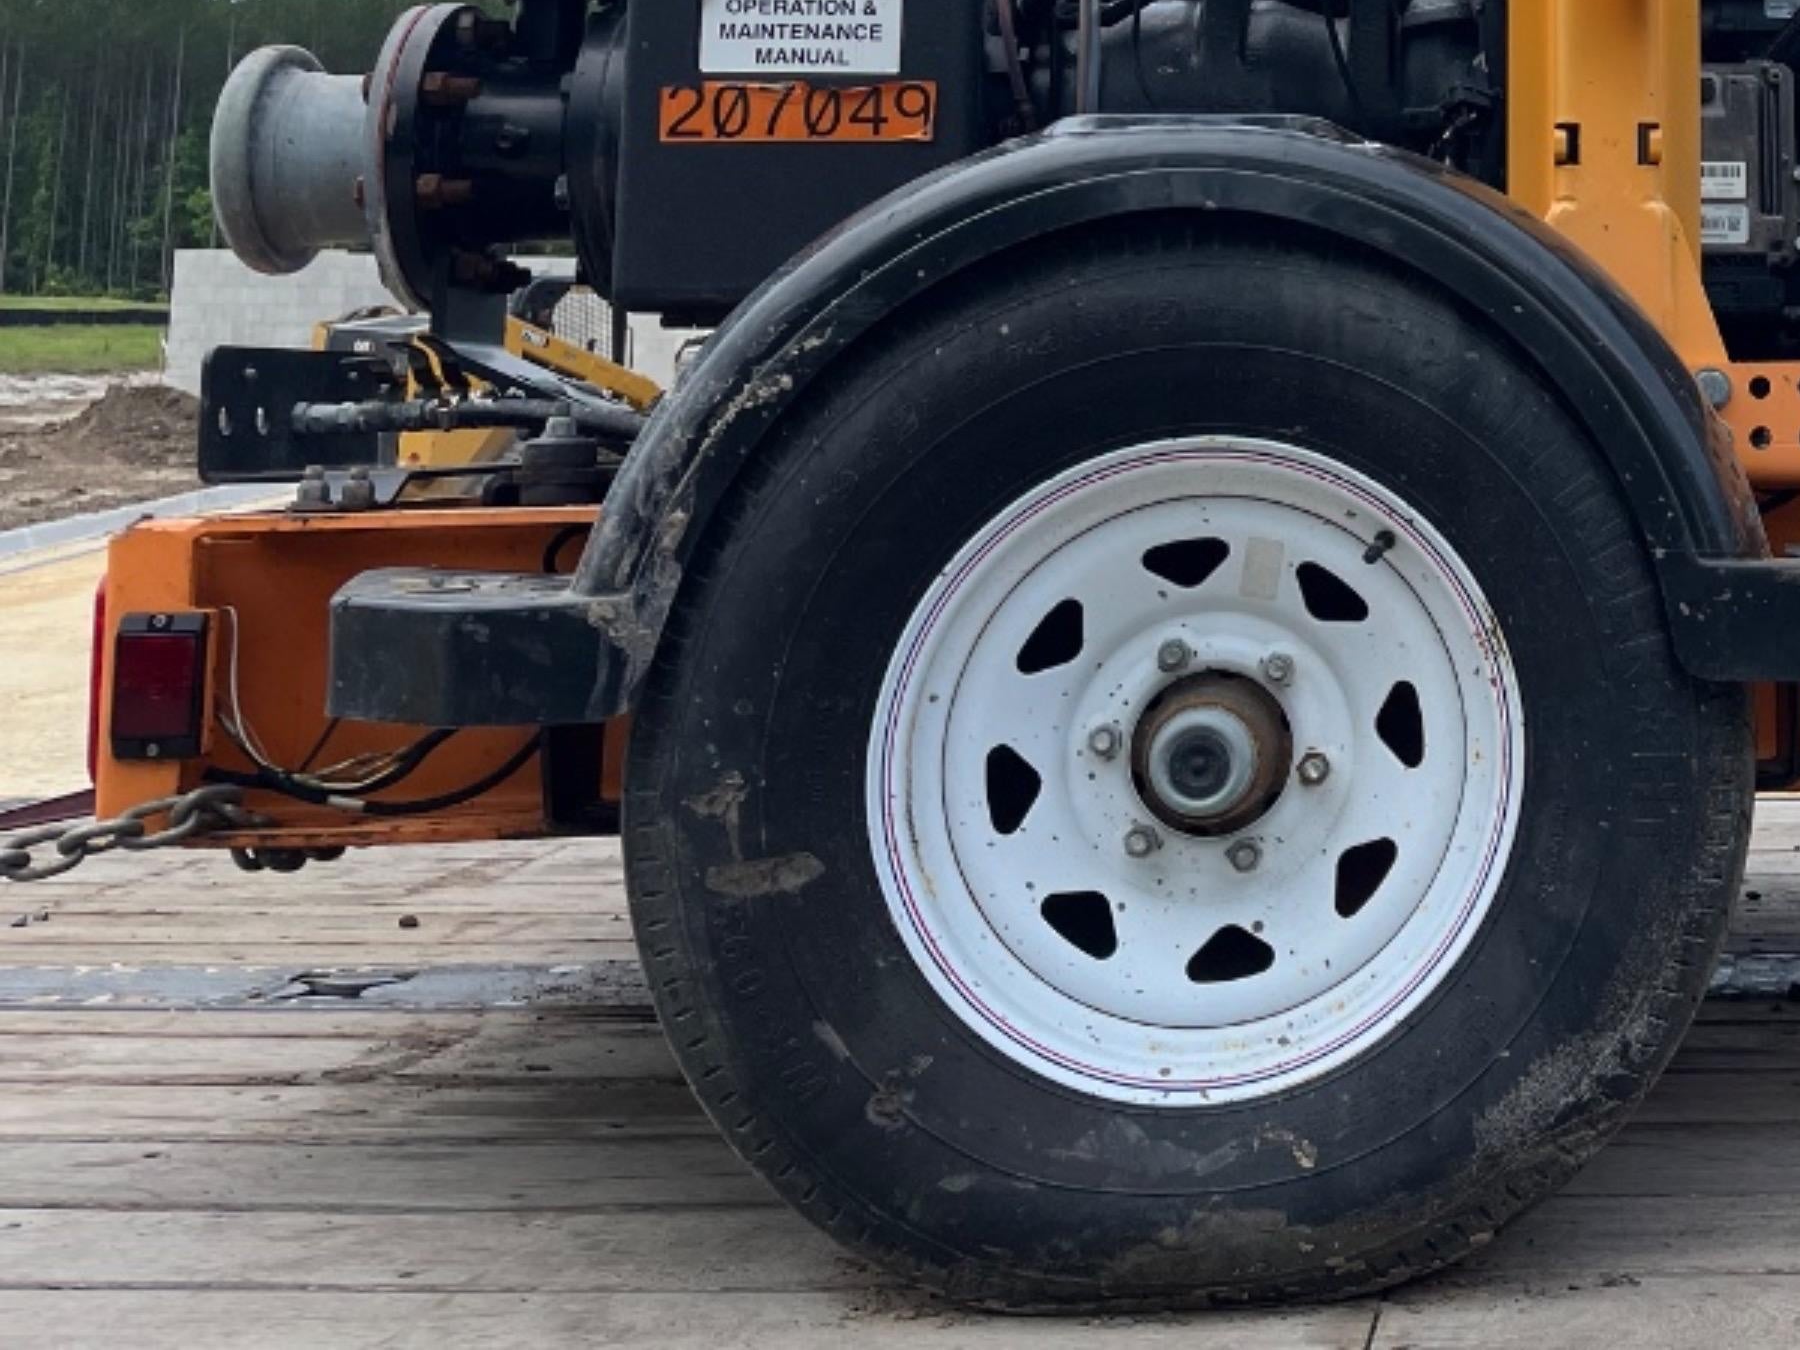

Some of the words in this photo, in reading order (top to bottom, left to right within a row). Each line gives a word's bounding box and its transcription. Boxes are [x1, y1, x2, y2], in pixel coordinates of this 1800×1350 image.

[862, 0, 877, 16] &
[718, 22, 883, 42] MAINTENANCE
[754, 47, 850, 66] MANUAL
[665, 83, 931, 138] 207049
